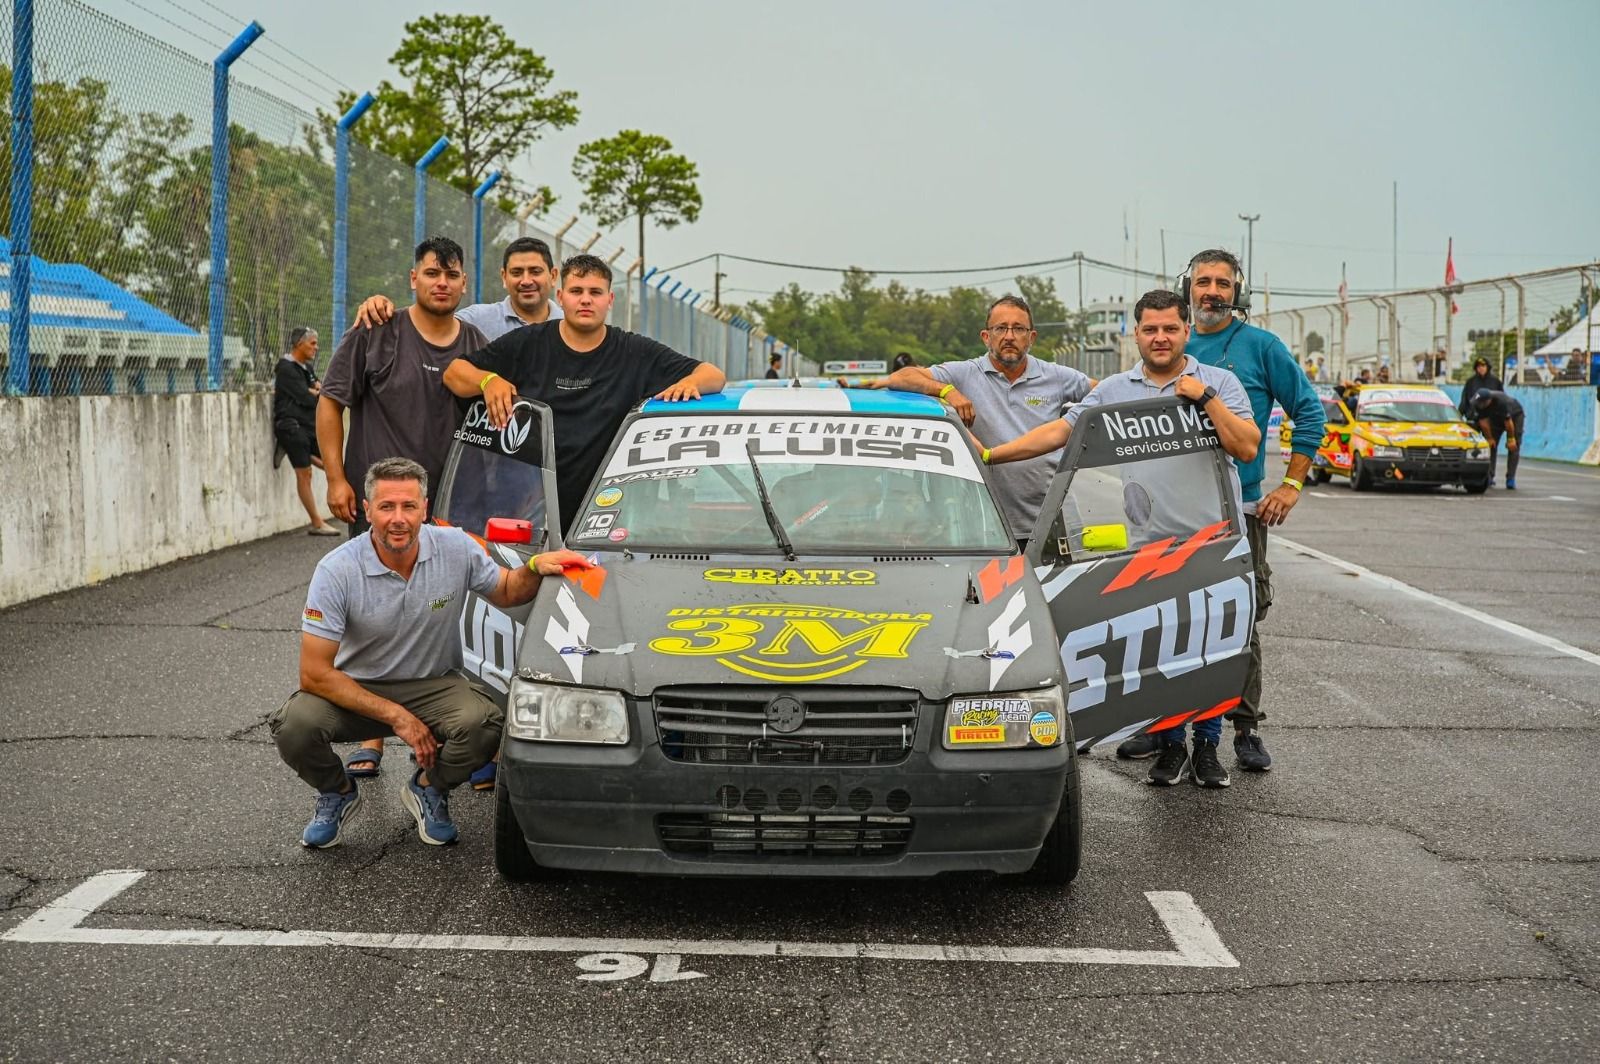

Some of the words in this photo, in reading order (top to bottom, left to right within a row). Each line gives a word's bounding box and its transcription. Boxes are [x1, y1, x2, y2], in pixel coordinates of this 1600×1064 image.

[466, 400, 498, 431] SA
[632, 421, 950, 445] ESTABLECIMIENTO
[1102, 411, 1175, 441] Nano
[627, 439, 720, 467] LA
[745, 437, 955, 468] LUISA
[1115, 440, 1180, 457] servicios
[1183, 439, 1193, 448] e
[587, 513, 614, 528] 10
[703, 567, 877, 582] CERATTO
[777, 577, 877, 585] Motores
[666, 606, 934, 621] DISTRIBUIDORA
[648, 617, 930, 658] 3M
[1060, 571, 1256, 714] STUD
[952, 699, 1031, 713] PIEDRITA
[962, 708, 1000, 727] Racing
[1001, 712, 1029, 722] Team
[955, 728, 1000, 740] PIRELLI
